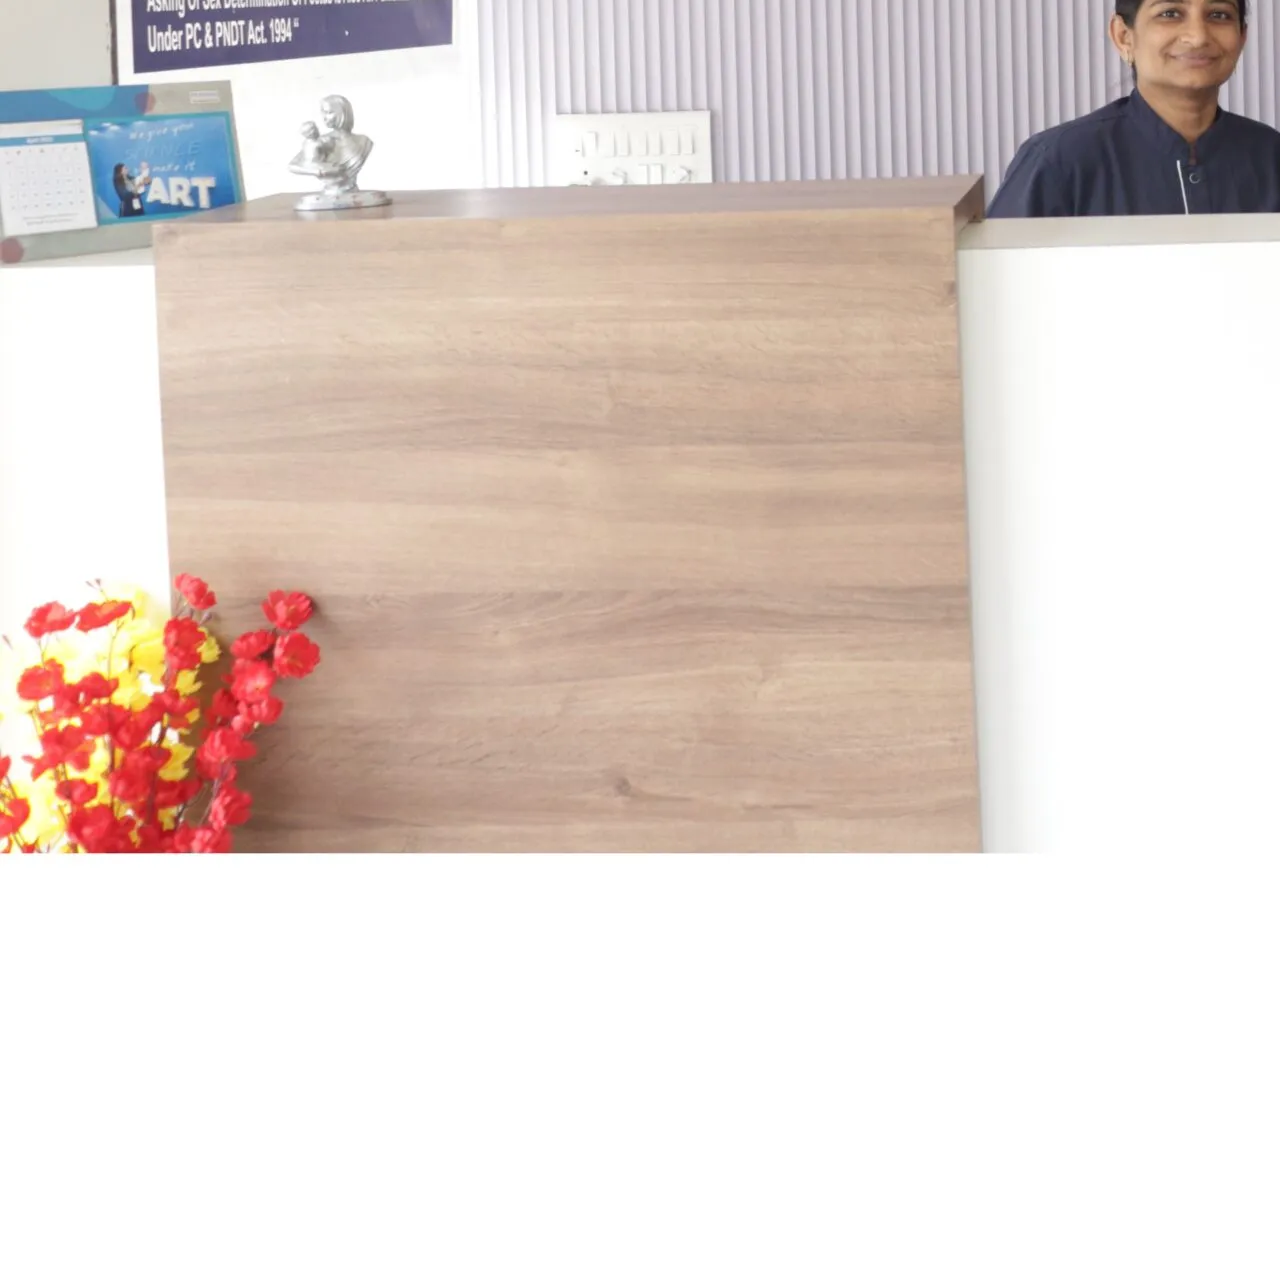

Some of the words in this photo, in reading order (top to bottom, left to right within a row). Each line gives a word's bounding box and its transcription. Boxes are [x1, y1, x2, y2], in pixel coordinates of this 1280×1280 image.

[147, 24, 184, 53] Under
[185, 22, 202, 49] PC
[204, 21, 214, 48] &
[215, 20, 245, 47] PNDT
[247, 19, 267, 45] Act.
[146, 176, 216, 209] ART
